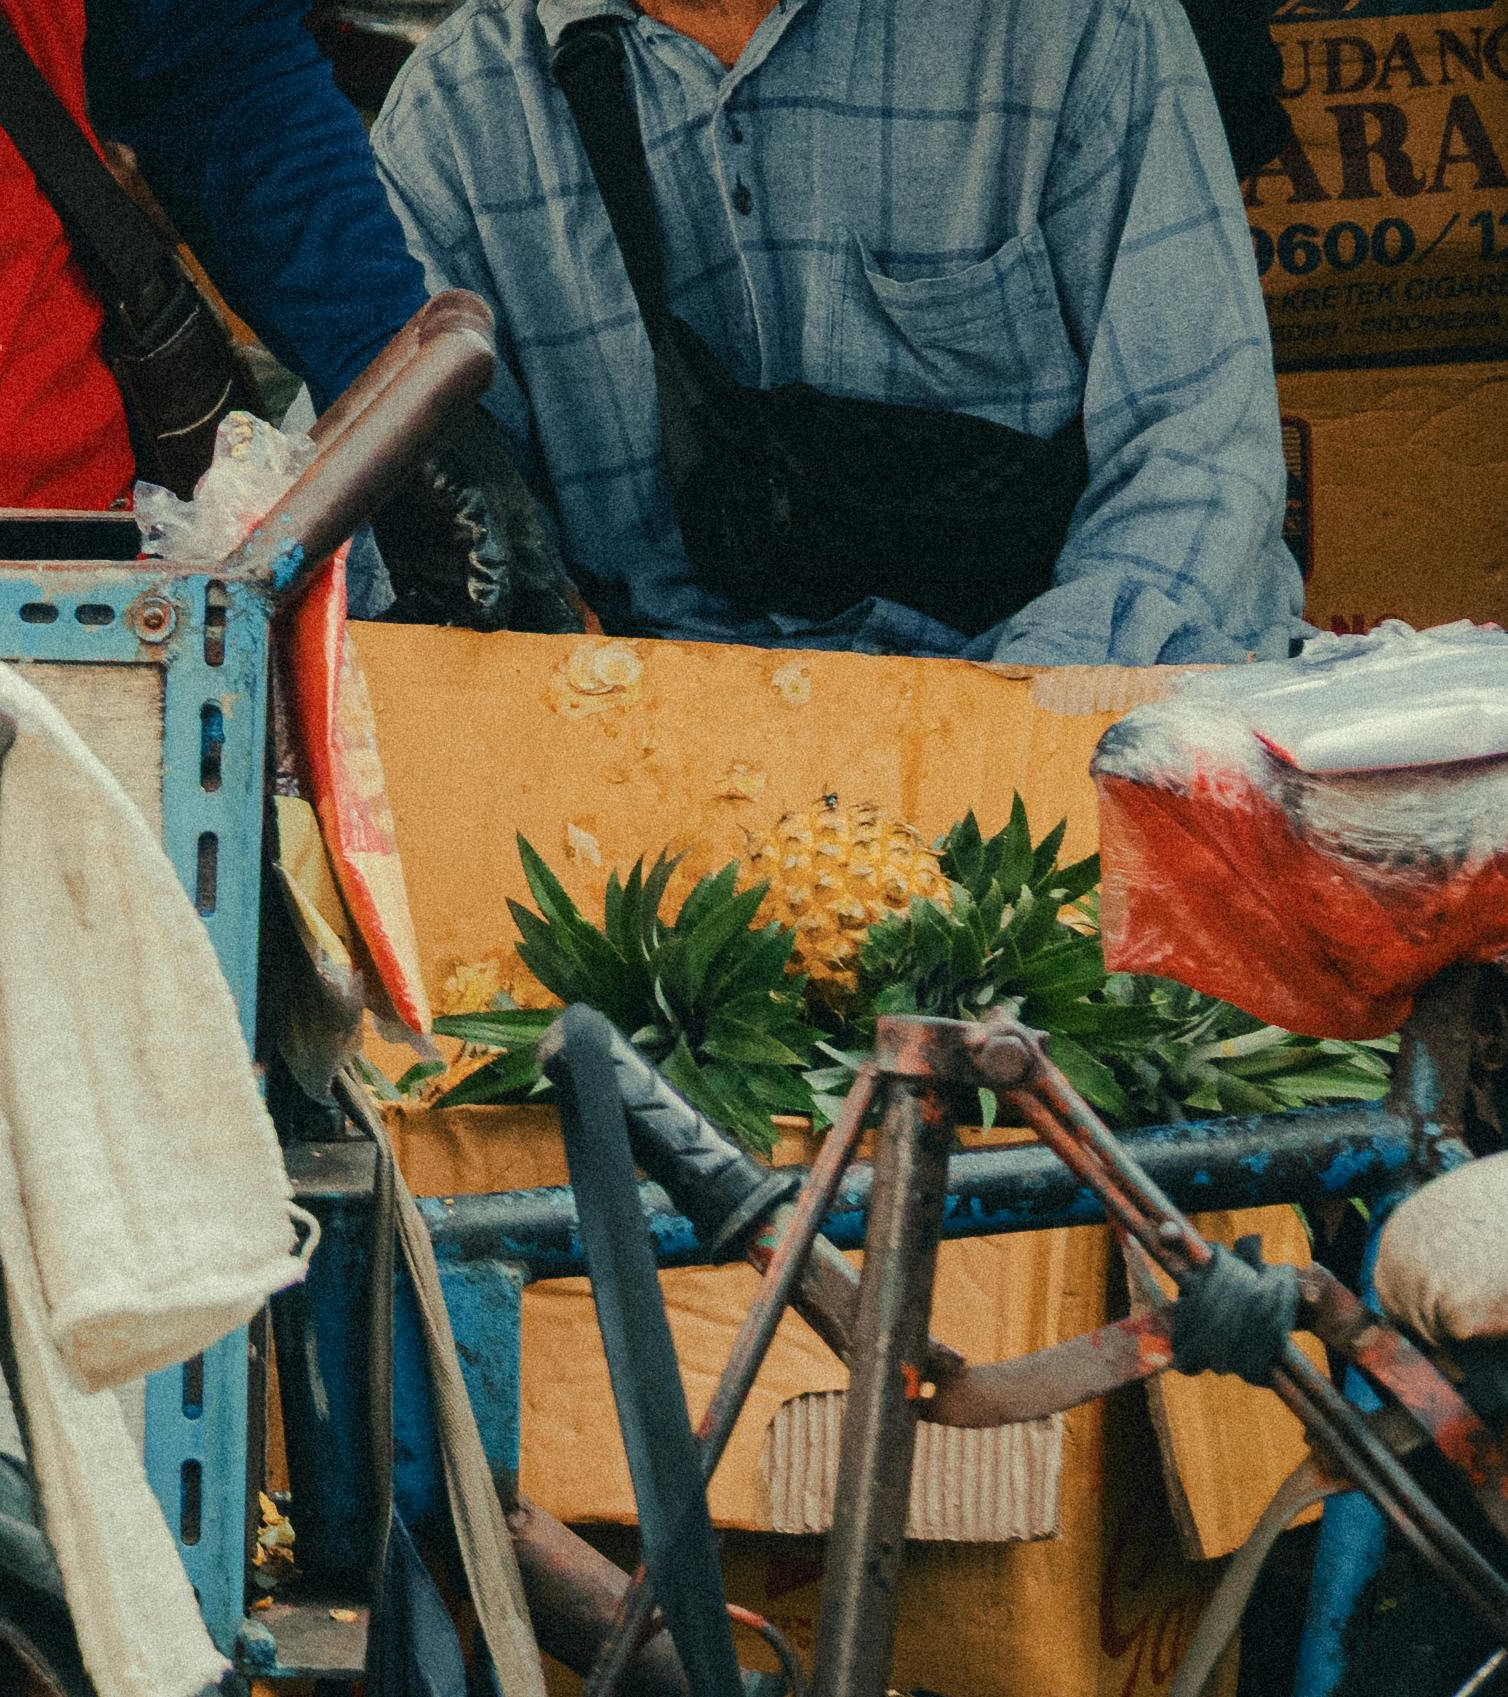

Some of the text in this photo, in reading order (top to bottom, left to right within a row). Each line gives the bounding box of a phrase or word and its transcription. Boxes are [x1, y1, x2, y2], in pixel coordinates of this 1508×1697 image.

[1273, 25, 1508, 100] UDAN
[1245, 93, 1508, 208] ARA
[1281, 280, 1399, 312] KRETEK
